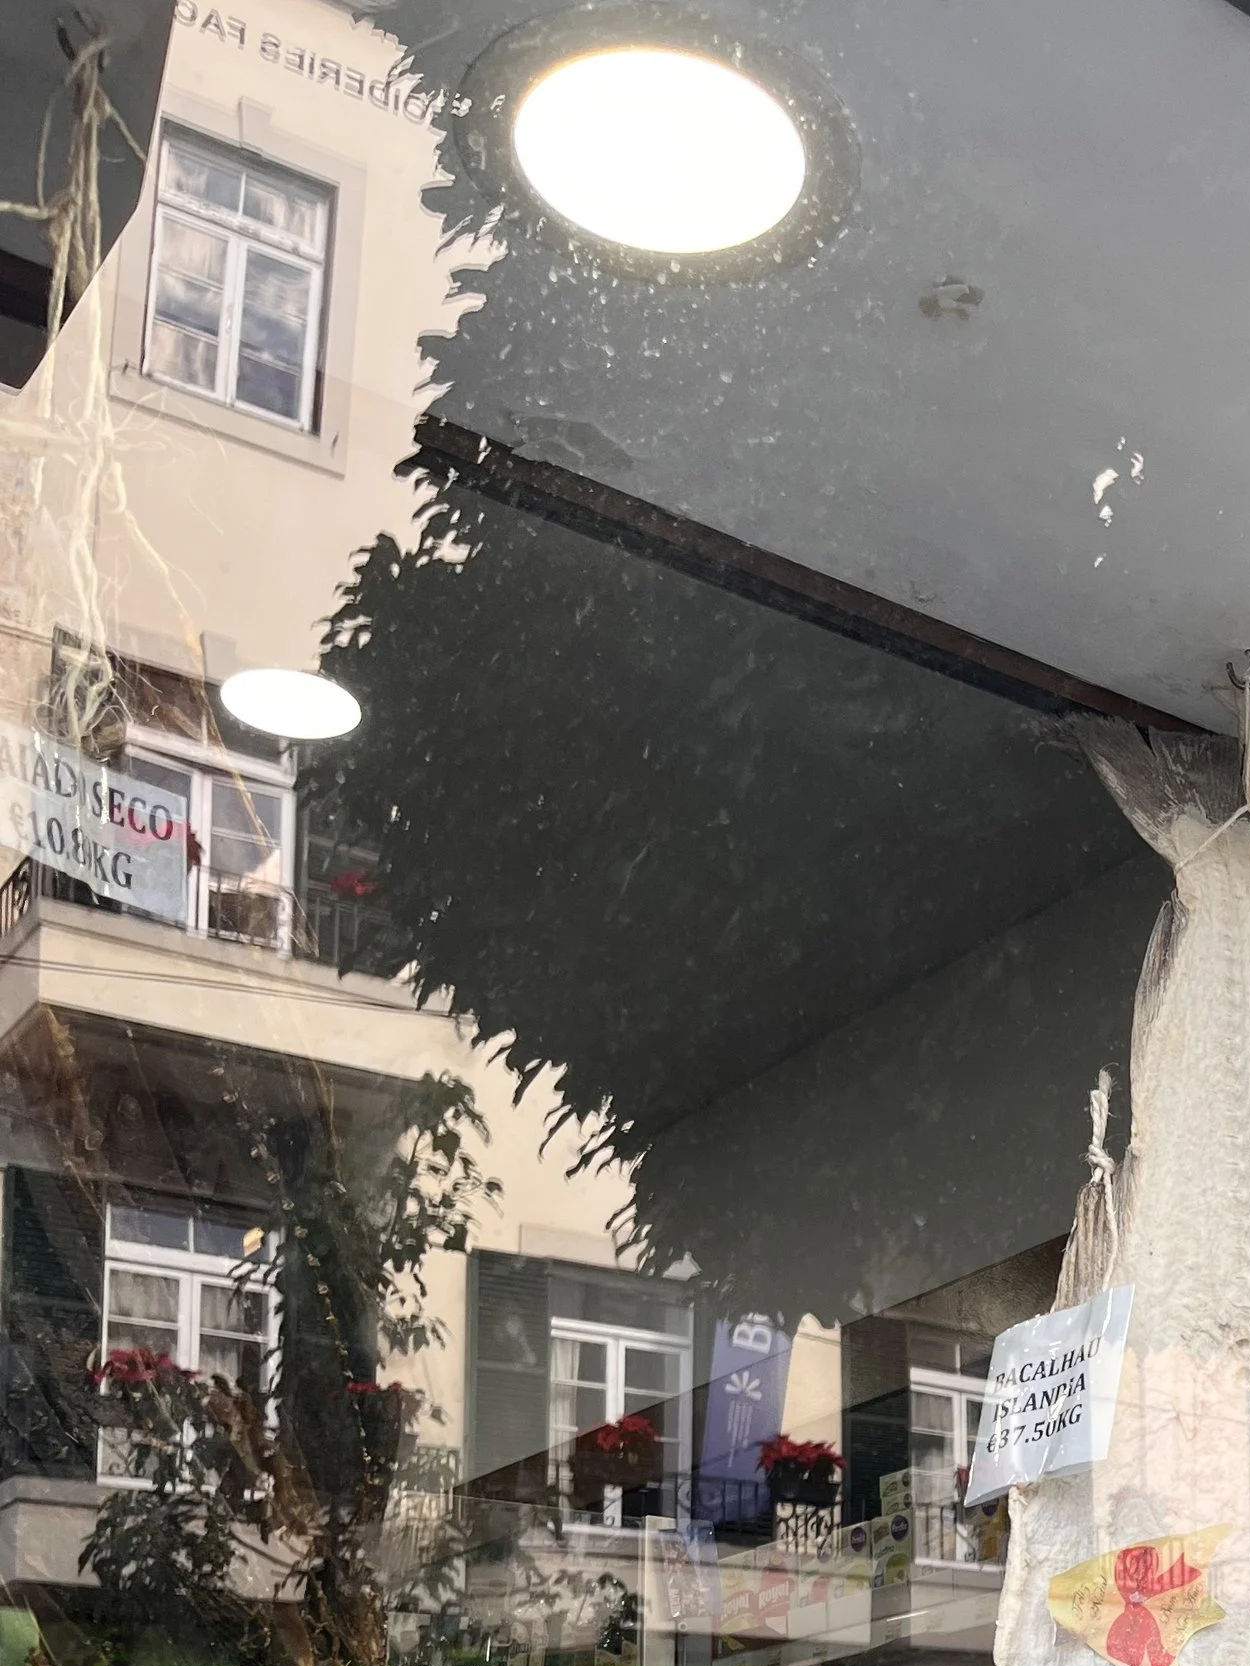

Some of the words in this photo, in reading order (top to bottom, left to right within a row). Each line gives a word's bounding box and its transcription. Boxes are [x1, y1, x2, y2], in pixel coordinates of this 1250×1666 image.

[92, 780, 174, 841] SECO
[994, 1336, 1101, 1394] BACALHAU
[987, 1404, 1082, 1453] €37.50KG
